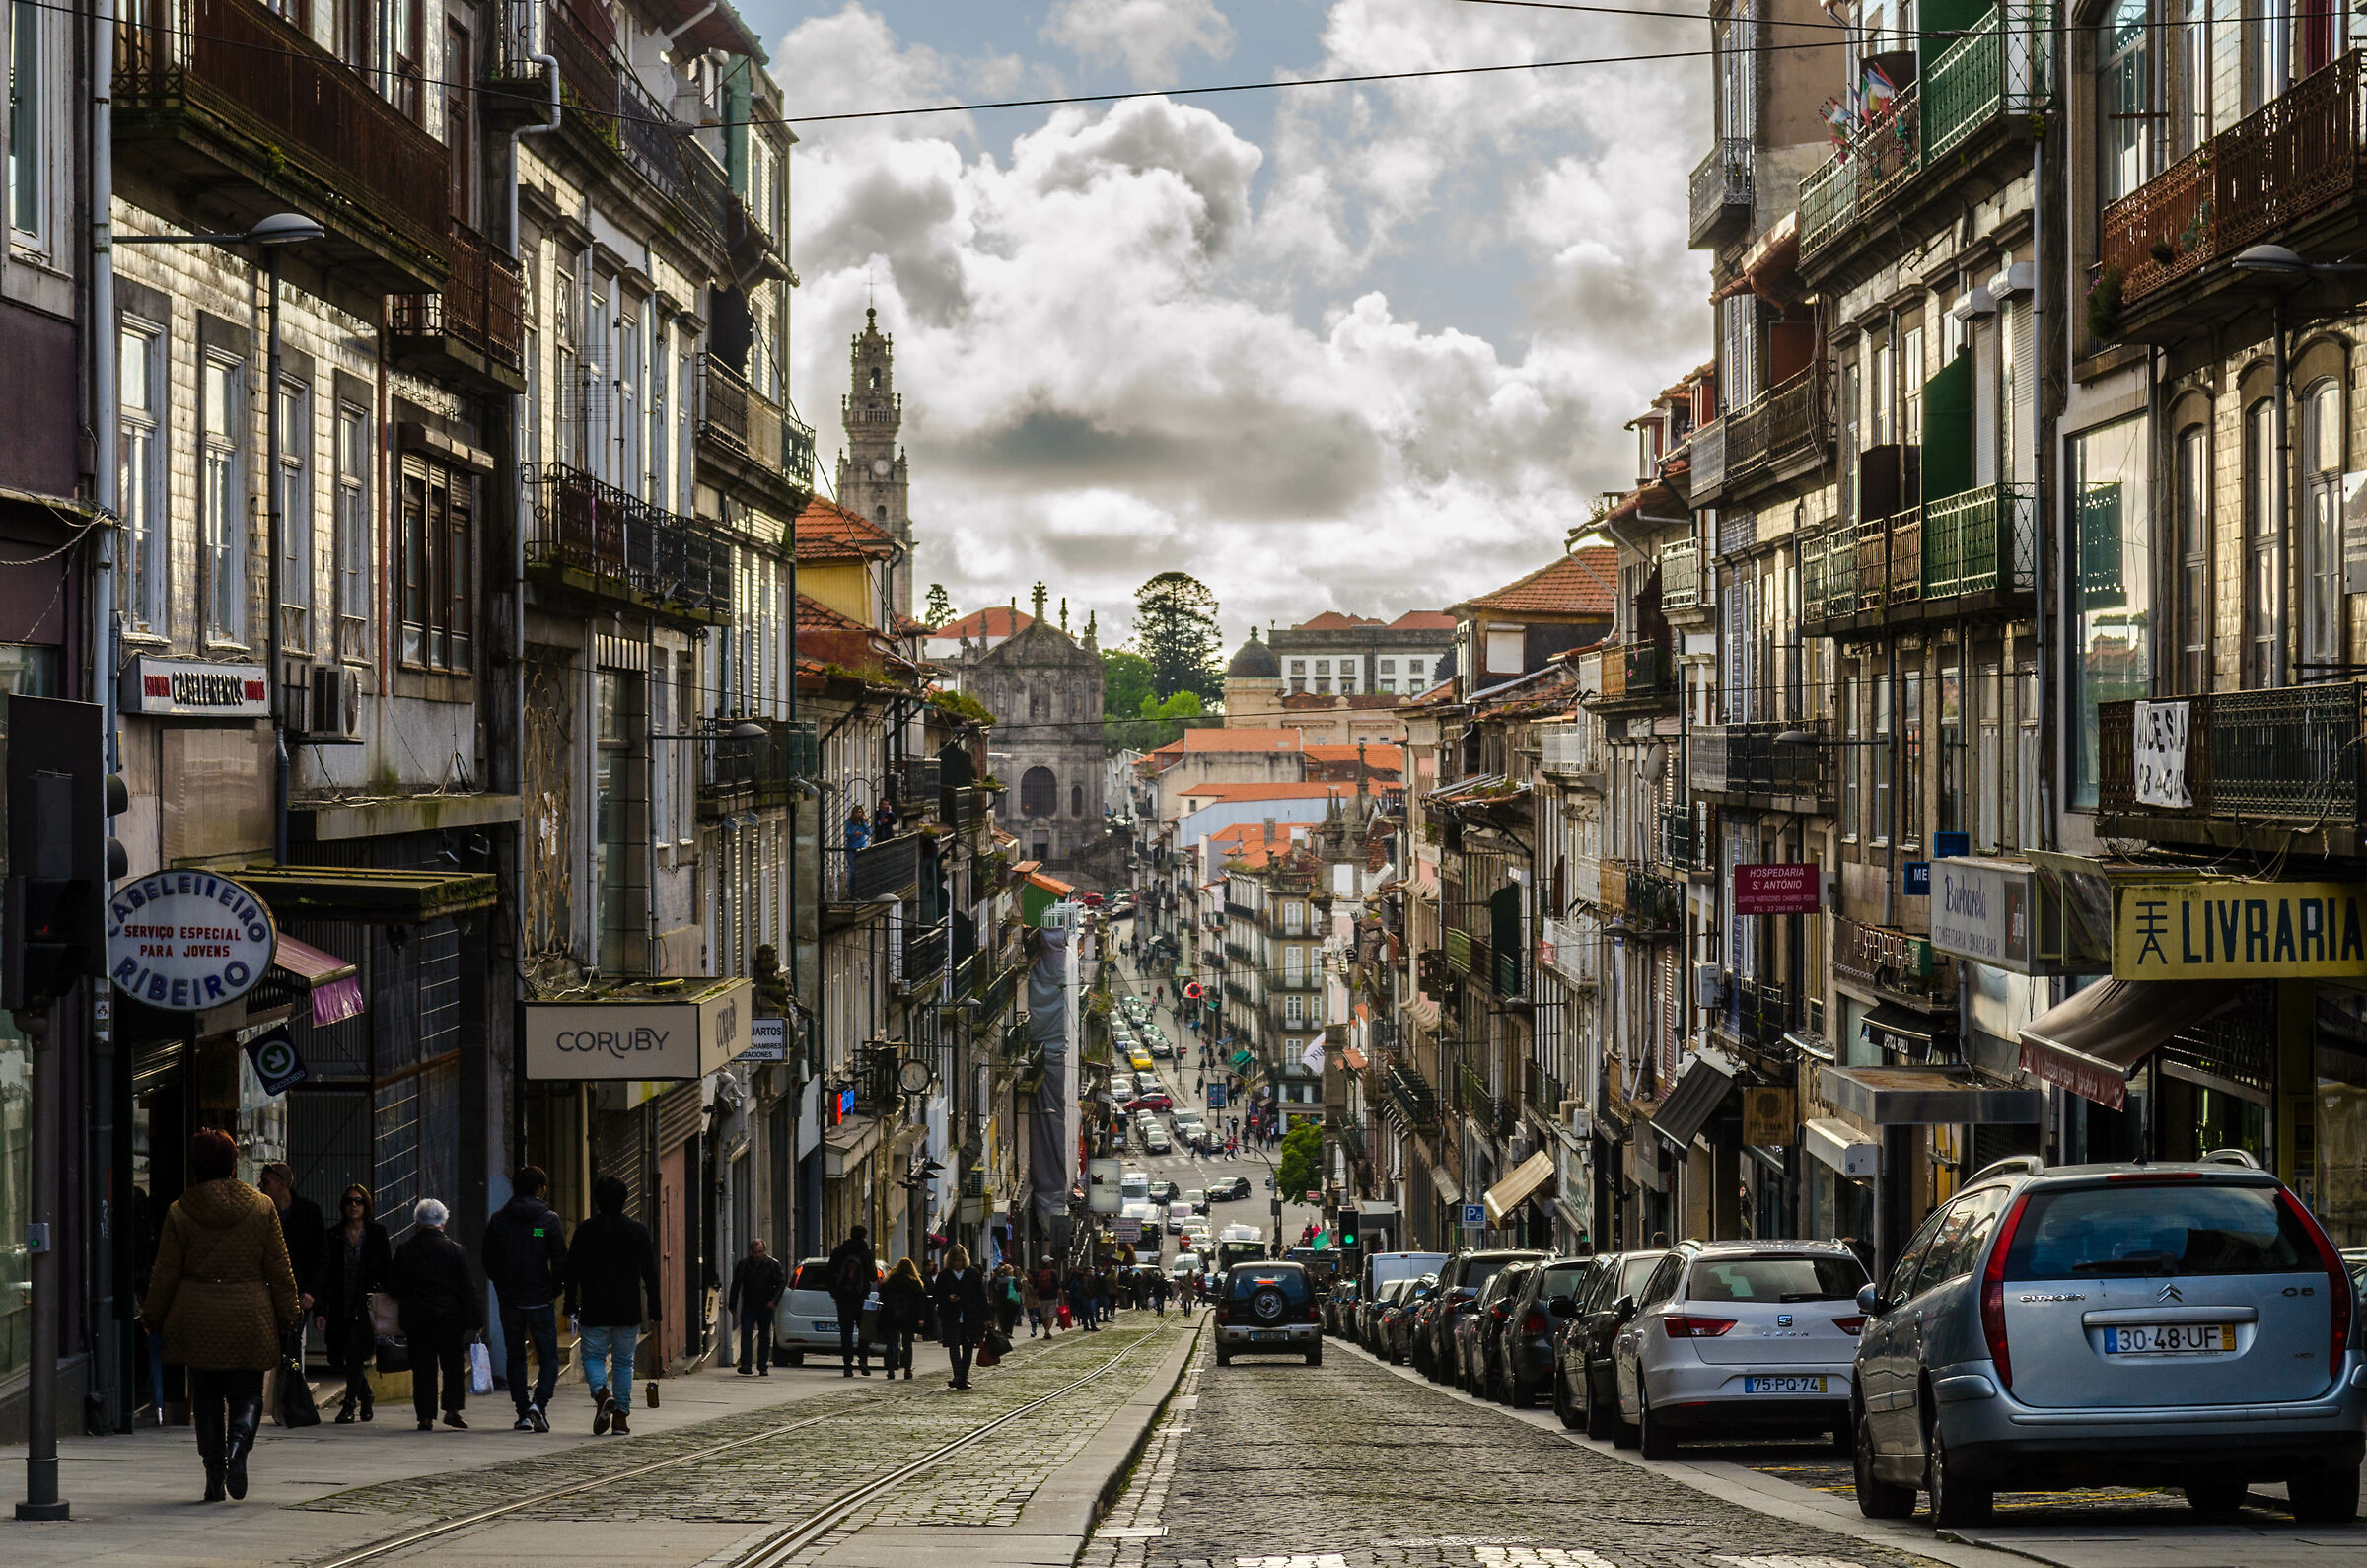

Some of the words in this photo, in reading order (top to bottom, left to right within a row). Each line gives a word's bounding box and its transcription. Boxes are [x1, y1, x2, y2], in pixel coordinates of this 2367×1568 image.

[173, 671, 244, 706] CABELEIREIROS
[1750, 868, 1805, 878] HOSPEDARIA
[1763, 878, 1803, 890] ANTÓNIO
[124, 925, 174, 941] SERVIÇO
[180, 926, 242, 941] ESPECIAL
[2182, 897, 2365, 964] LIVRARIA
[140, 944, 174, 958] PARA
[183, 944, 231, 958] JOVENS
[113, 956, 251, 1006] RIBEIRO
[751, 1027, 782, 1036] UARTOS
[556, 1027, 670, 1059] CORUBY
[1467, 1207, 1476, 1220] P
